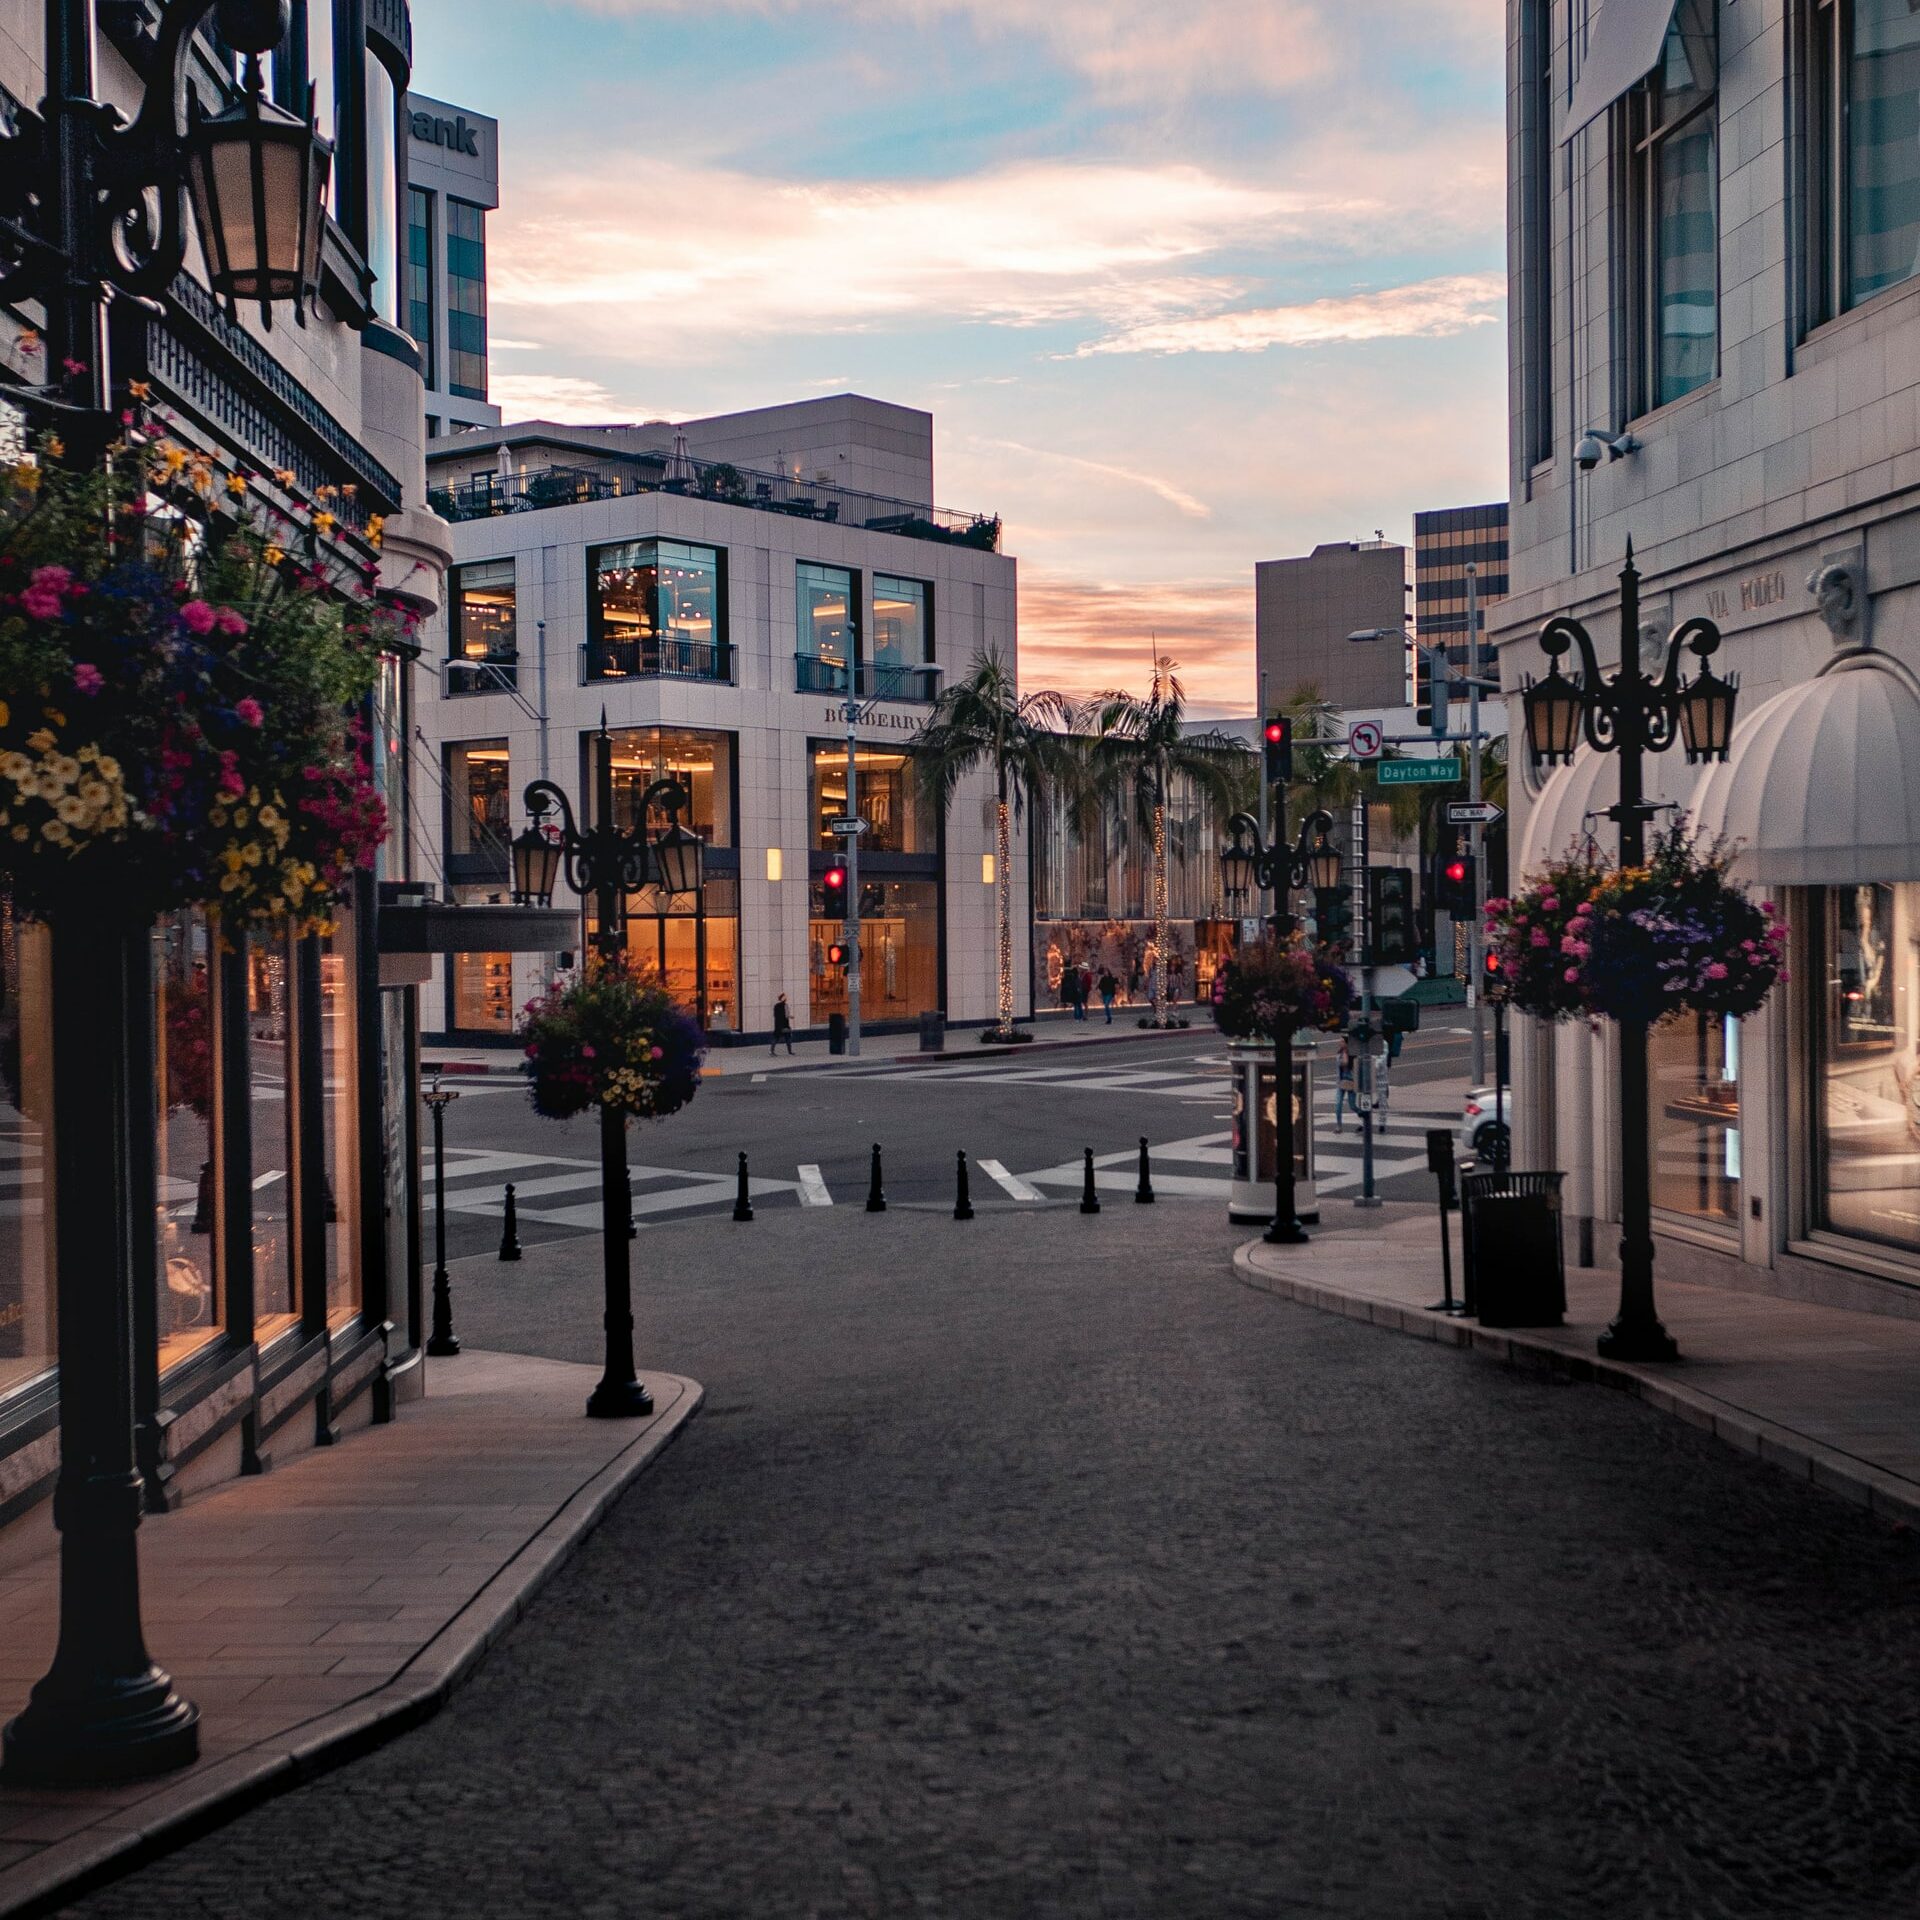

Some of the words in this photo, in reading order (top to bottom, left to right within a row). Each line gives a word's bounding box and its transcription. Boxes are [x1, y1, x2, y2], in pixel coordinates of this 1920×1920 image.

[1706, 590, 1729, 618] VIA
[1384, 766, 1427, 780] Dayton
[1430, 764, 1455, 778] Way
[1453, 809, 1468, 817] ONE
[1470, 809, 1484, 817] WAY
